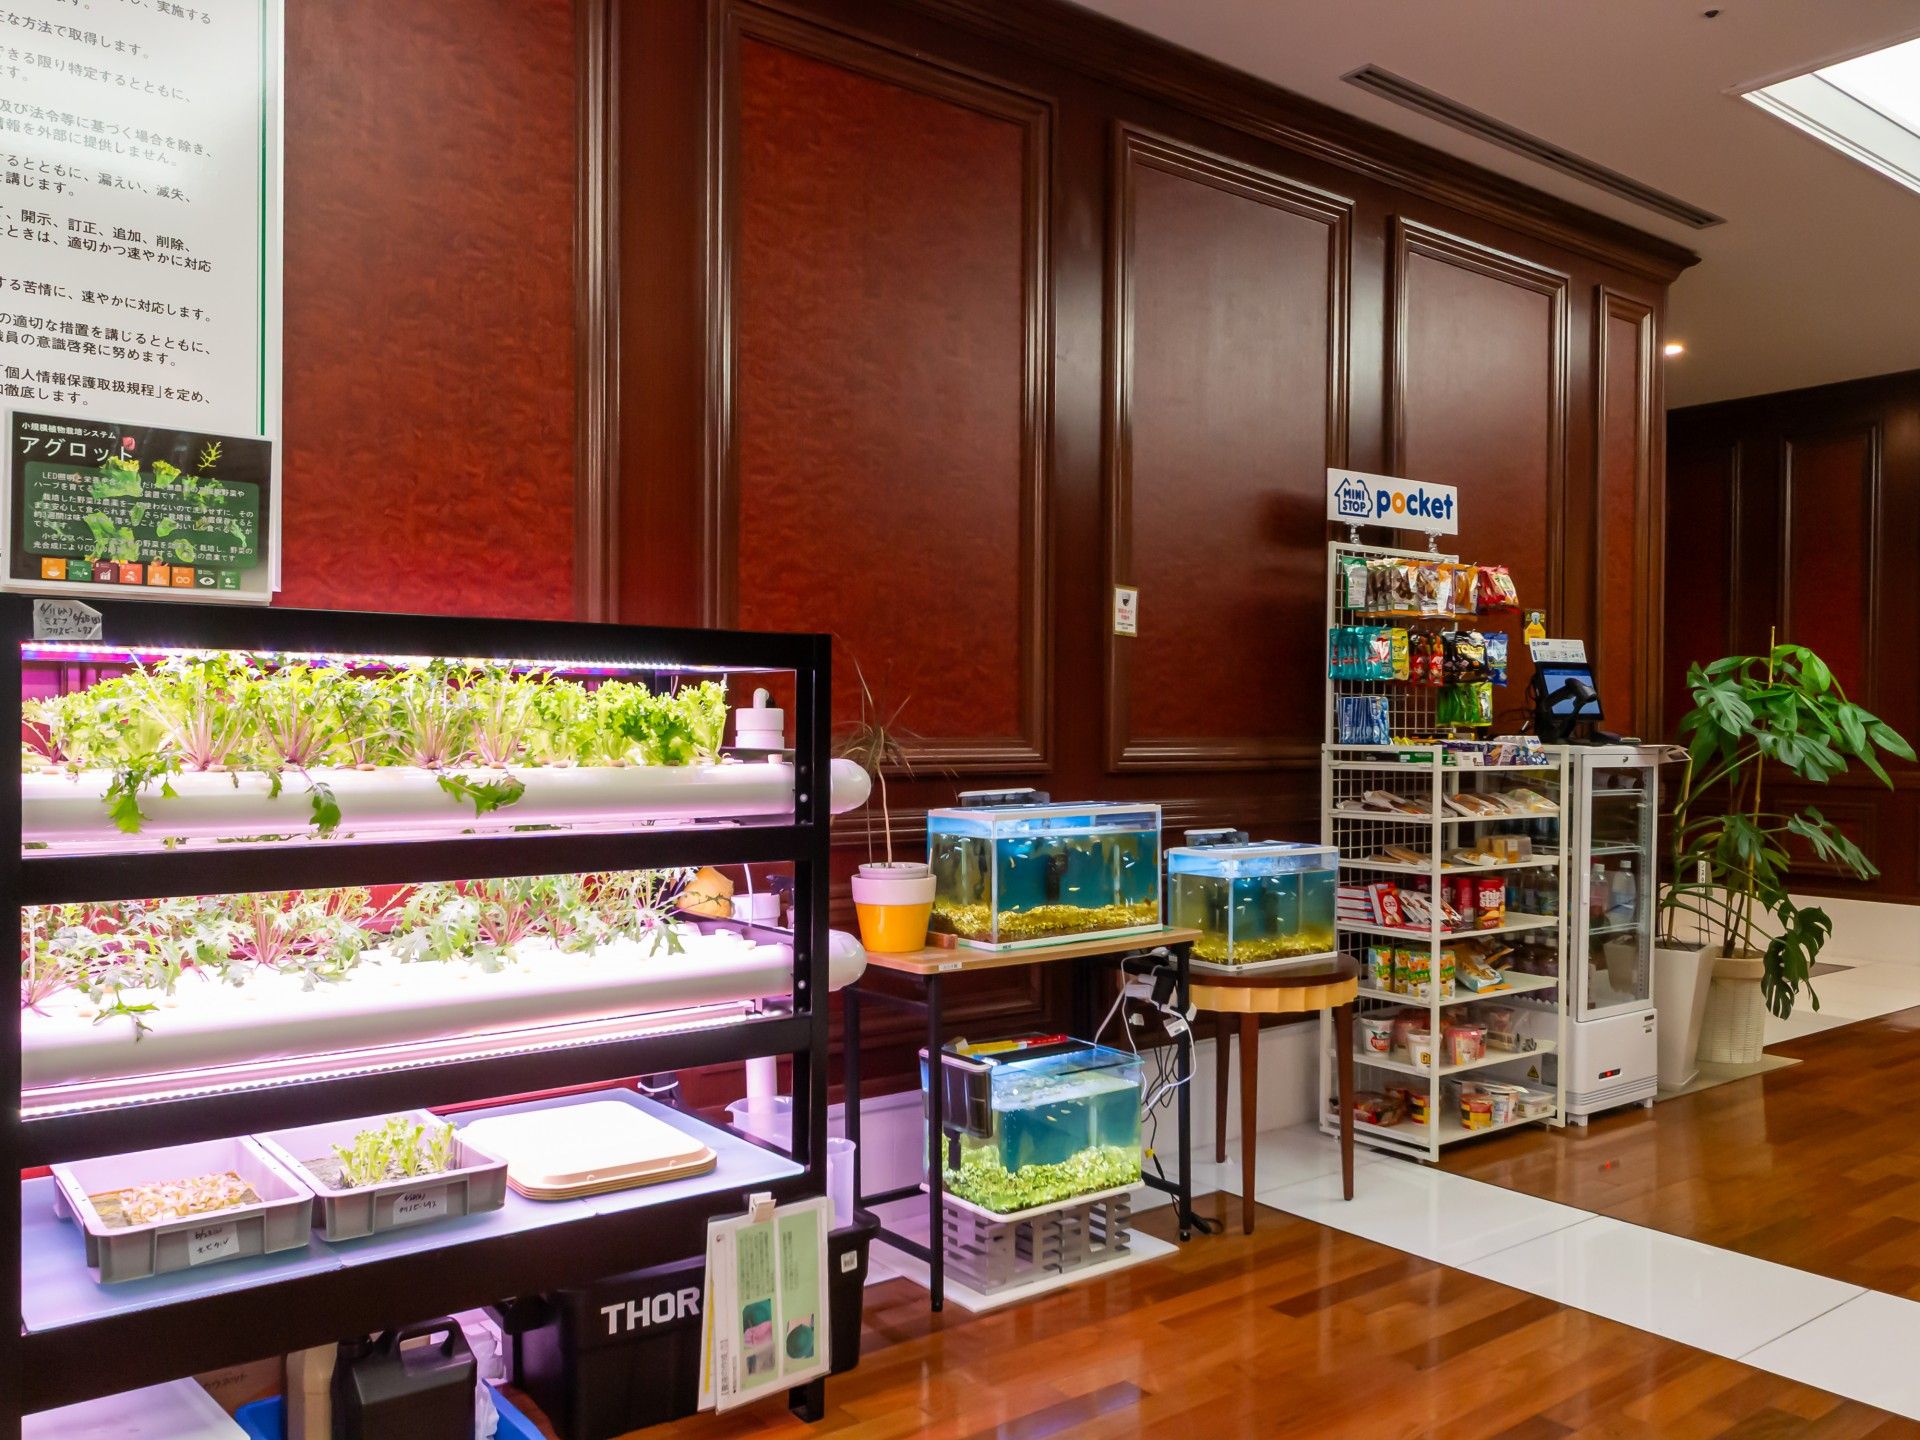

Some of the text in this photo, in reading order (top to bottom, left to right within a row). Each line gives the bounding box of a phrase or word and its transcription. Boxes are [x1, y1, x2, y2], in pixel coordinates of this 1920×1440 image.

[0, 154, 193, 204] るとともに、漏えい、滅失、
[0, 171, 75, 198] 講じます。
[0, 205, 192, 253] 、開示、訂正、追加、削除、
[0, 224, 213, 274] ときは、適切かつ速やかに対応
[21, 421, 117, 440] 小規模植物栽培システム
[20, 436, 133, 461] アグロット
[1342, 500, 1366, 512] STOP
[1343, 488, 1365, 501] MINI
[1376, 487, 1454, 519] pocket
[600, 1285, 701, 1336] THOR
